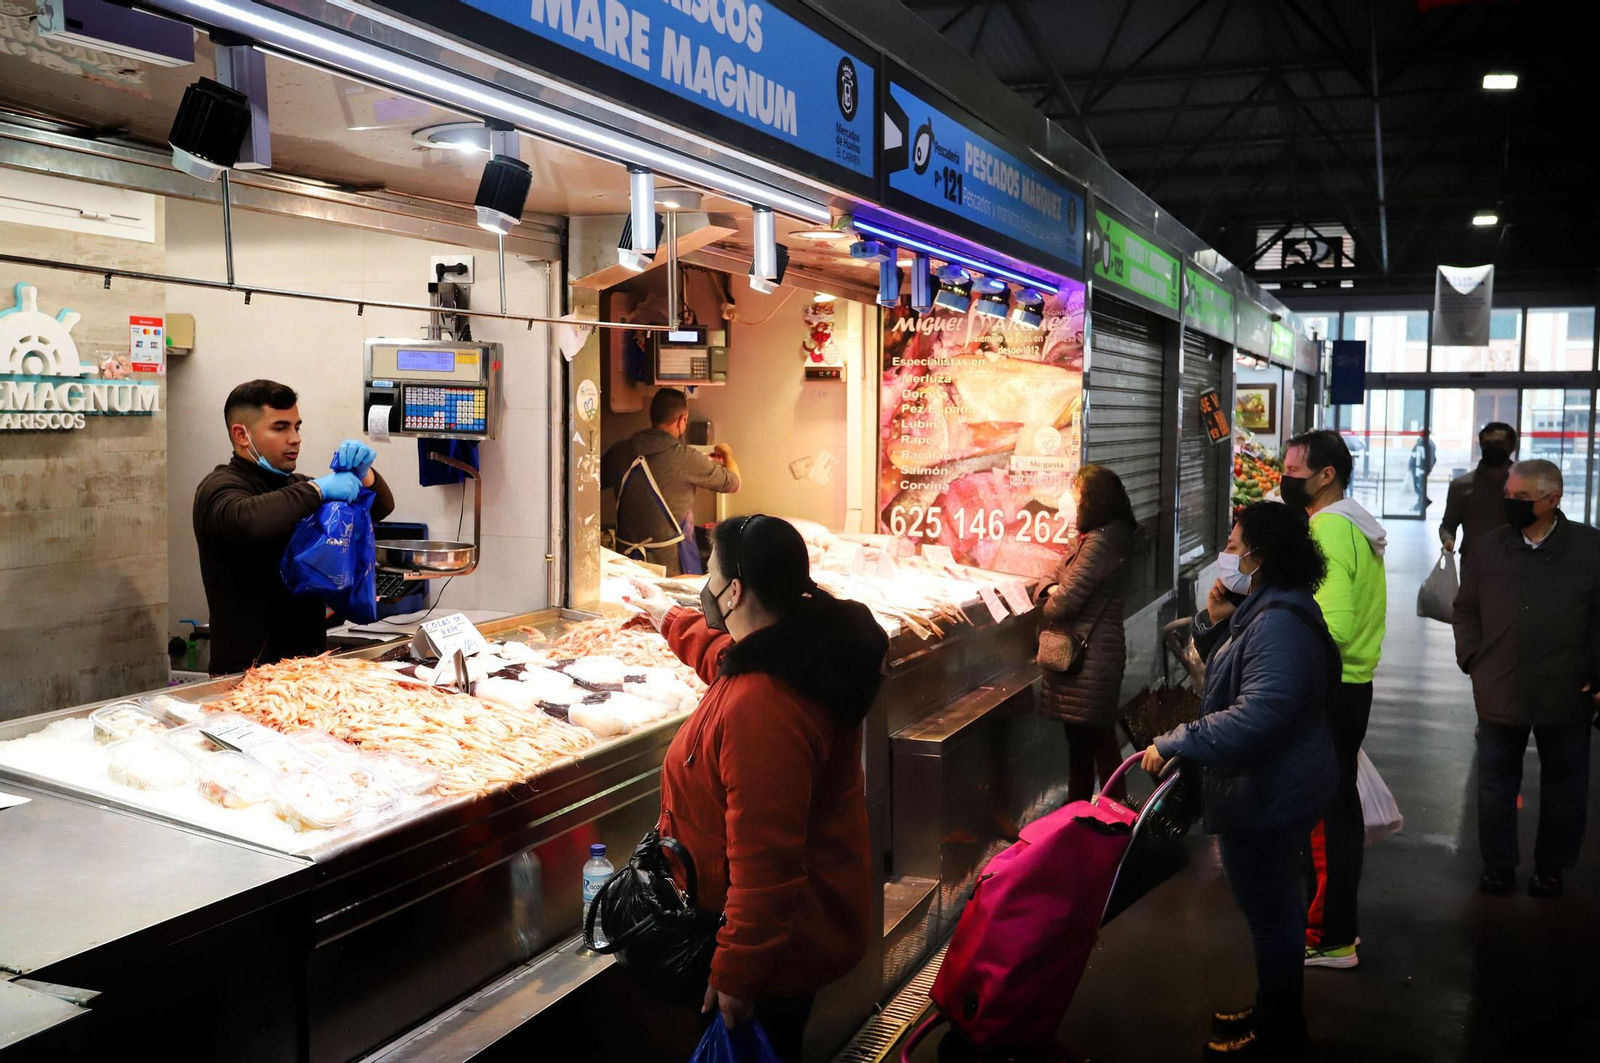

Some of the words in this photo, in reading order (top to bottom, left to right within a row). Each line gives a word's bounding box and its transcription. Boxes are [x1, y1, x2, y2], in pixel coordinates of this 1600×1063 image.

[661, 26, 798, 137] MAGNUM
[836, 121, 860, 143] Mercados
[964, 140, 1020, 200] PESCADOS
[998, 345, 1021, 355] desde
[1022, 346, 1040, 355] 1912
[892, 356, 968, 367] Especialistas
[970, 359, 985, 367] en
[902, 373, 952, 384] Merluza
[0, 381, 161, 412] MAGNUM
[902, 389, 949, 399] Dorada
[901, 404, 925, 414] Pez
[0, 412, 86, 430] ARISCOS
[901, 435, 934, 446] Rape
[901, 450, 952, 460] Bacalao
[900, 465, 948, 475] Salmón
[1030, 460, 1040, 468] Me
[1042, 461, 1065, 471] gusta
[900, 480, 950, 490] Corvina
[890, 504, 942, 538] 625
[953, 507, 1005, 542] 146
[1015, 509, 1069, 544] 262
